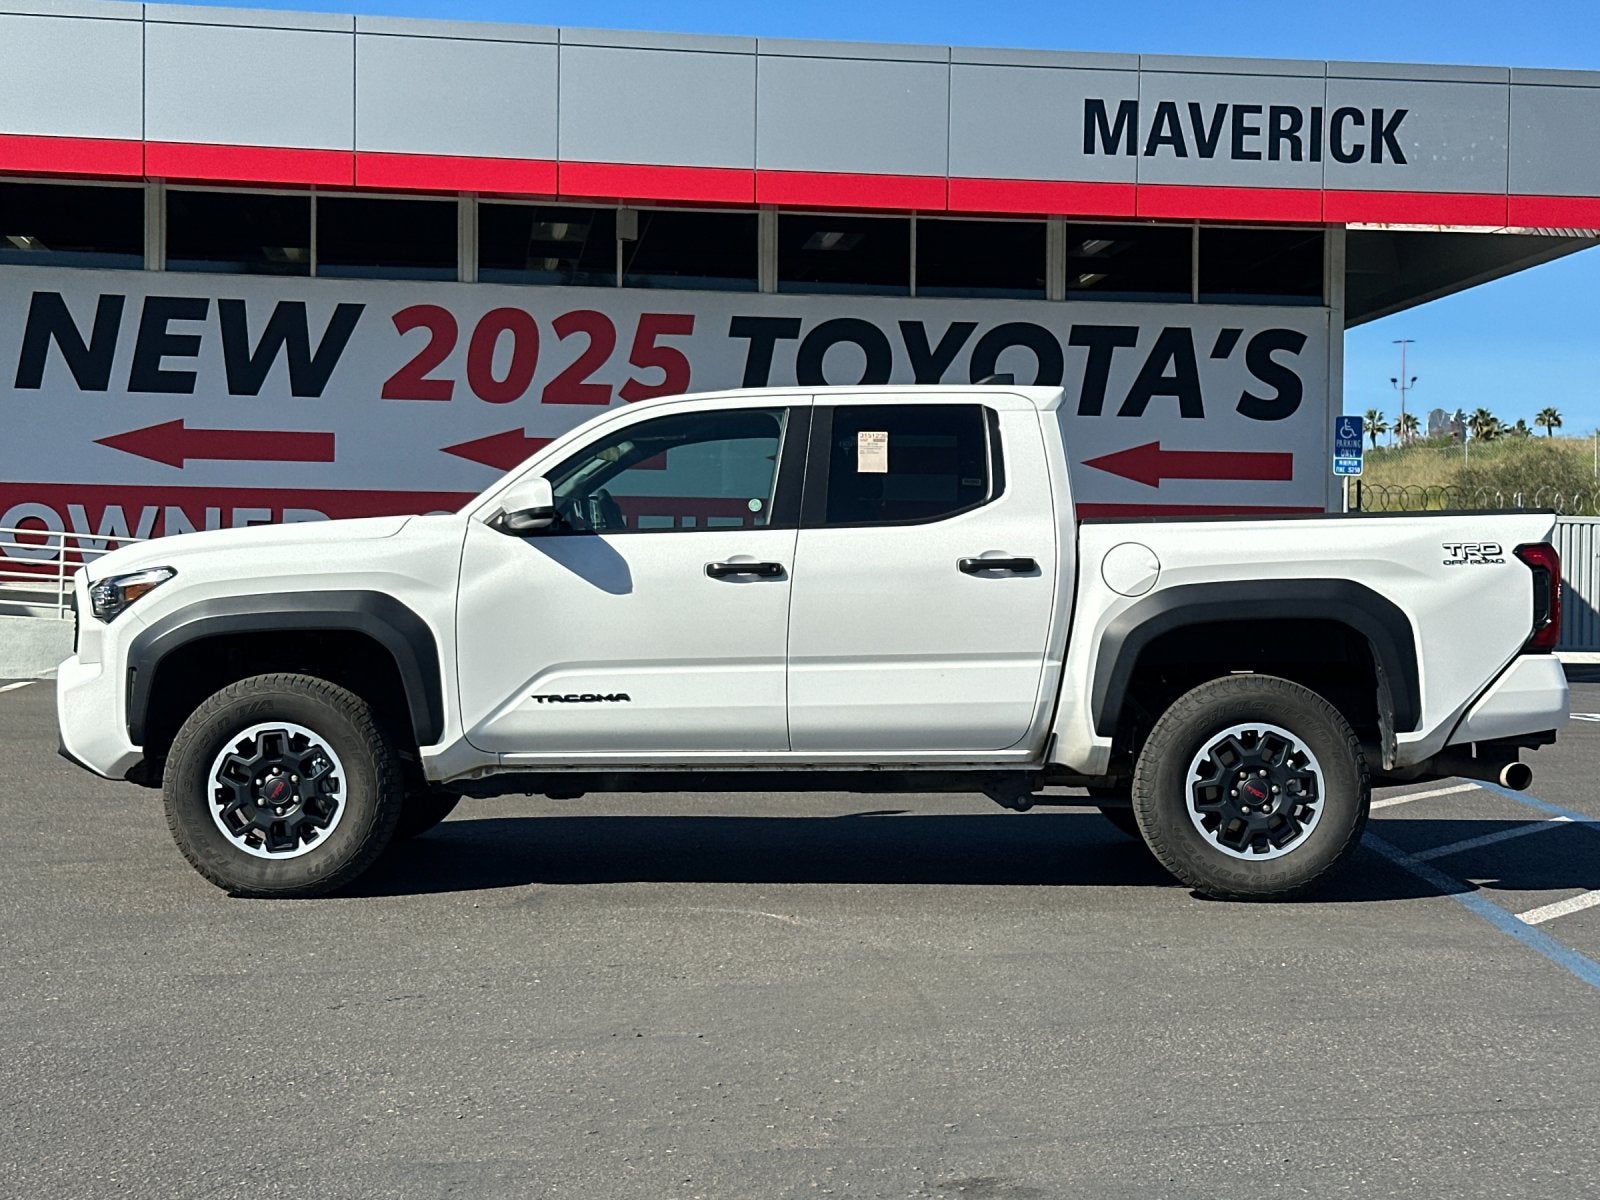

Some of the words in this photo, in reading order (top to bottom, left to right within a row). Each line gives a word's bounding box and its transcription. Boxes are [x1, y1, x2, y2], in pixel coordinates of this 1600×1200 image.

[1084, 98, 1408, 165] MAVERICK
[14, 292, 366, 397] NEW
[381, 304, 695, 405] 2025
[728, 315, 1308, 421] TOYOTA'S
[1336, 439, 1361, 448] PARKING
[1340, 449, 1357, 457] ONLY
[1442, 542, 1503, 560] TRD
[531, 693, 631, 703] TACOMA
[1246, 784, 1266, 798] TRD
